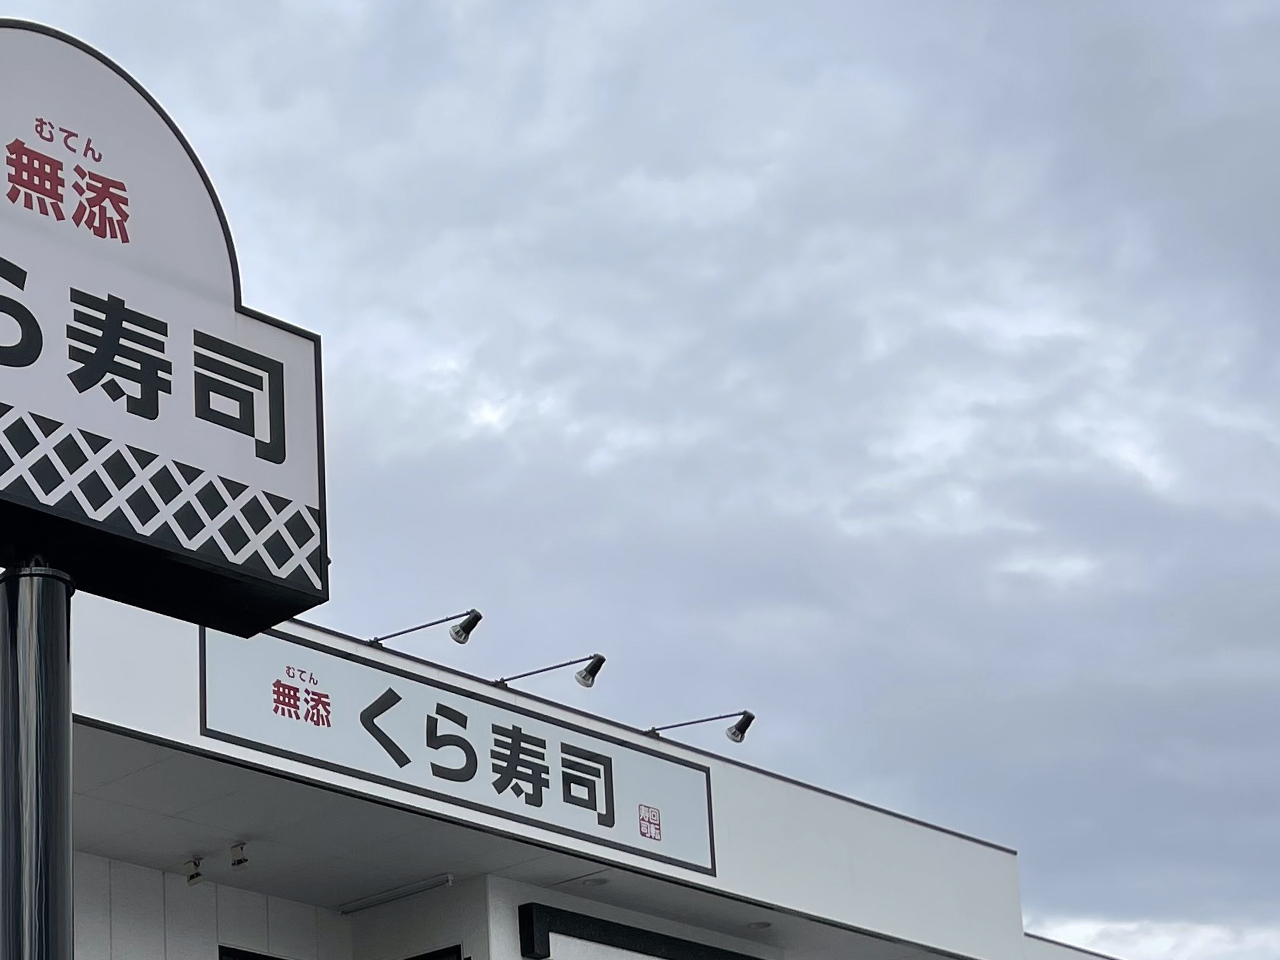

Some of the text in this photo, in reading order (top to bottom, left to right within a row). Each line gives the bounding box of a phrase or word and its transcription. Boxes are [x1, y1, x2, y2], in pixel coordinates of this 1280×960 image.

[34, 117, 103, 163] むてん
[6, 138, 130, 244] 無添
[285, 665, 319, 686] むてん
[272, 679, 331, 728] 無添
[359, 687, 616, 828] くら寿司
